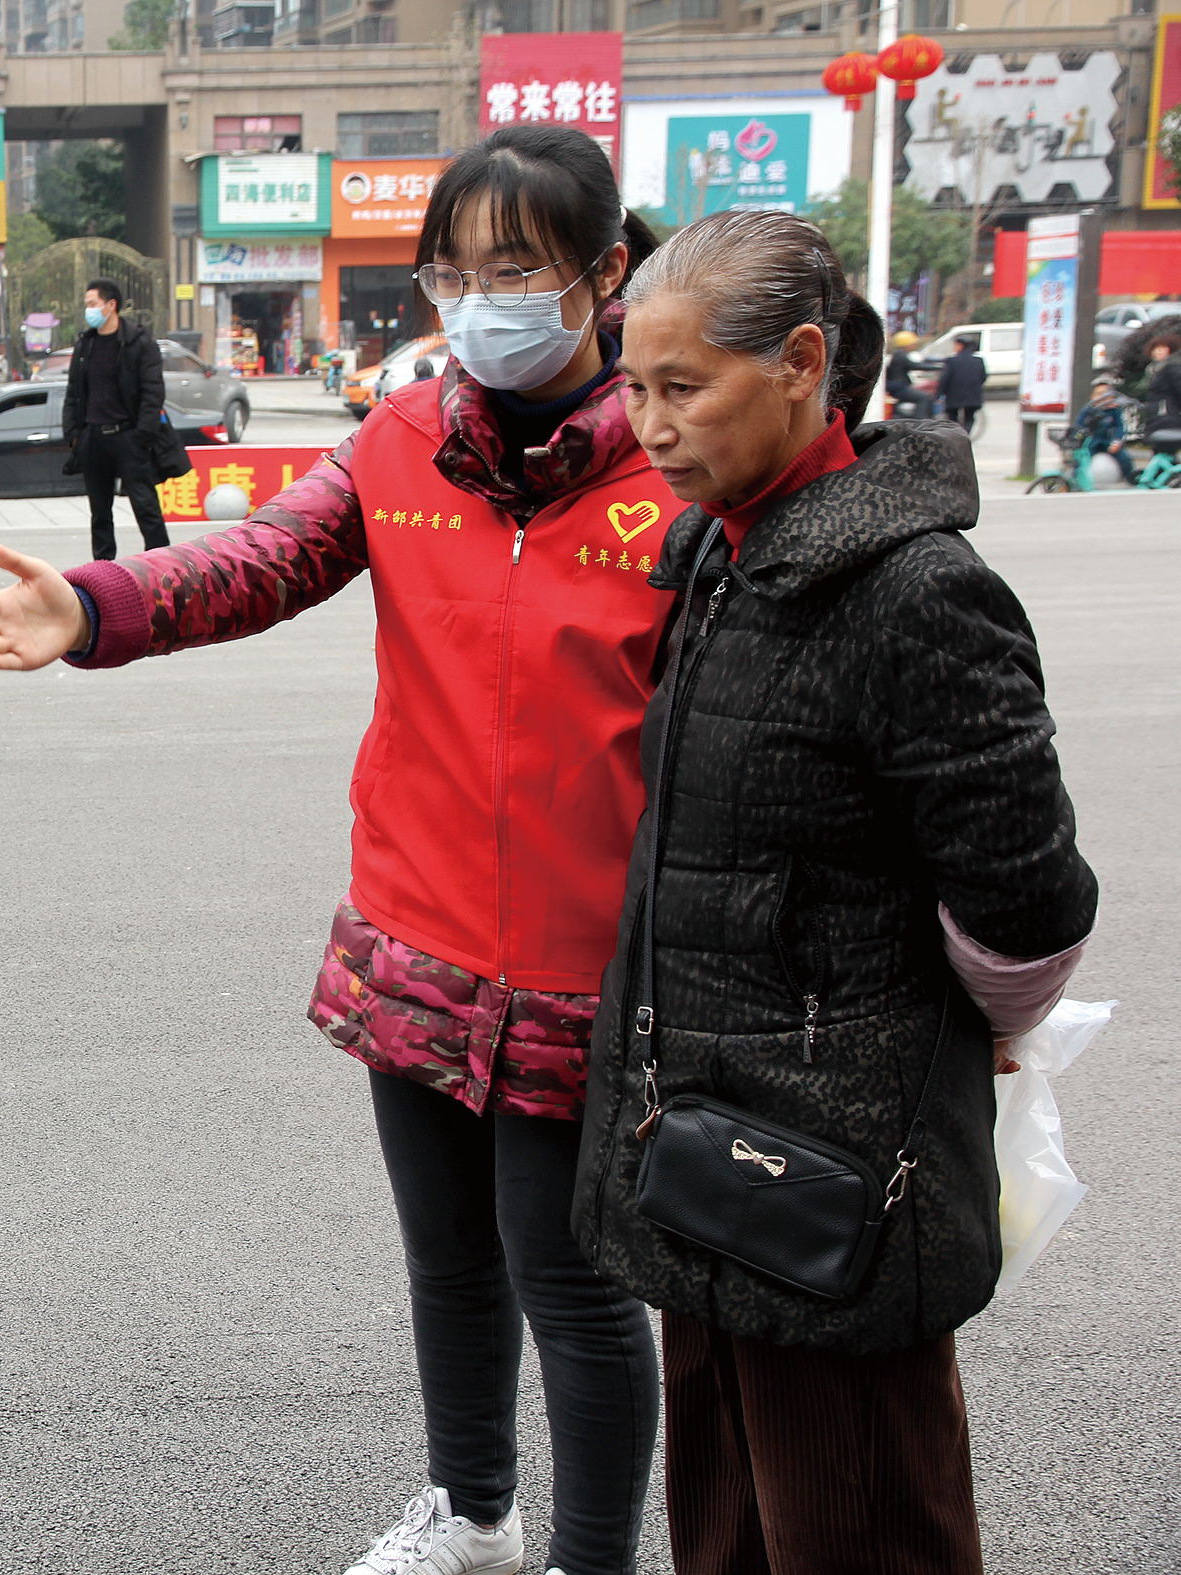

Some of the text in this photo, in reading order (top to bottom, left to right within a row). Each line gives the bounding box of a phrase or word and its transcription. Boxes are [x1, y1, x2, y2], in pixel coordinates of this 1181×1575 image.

[486, 79, 616, 123] 常来常往
[372, 509, 462, 531] 新邵共青团
[573, 545, 653, 573] 青年志愿
